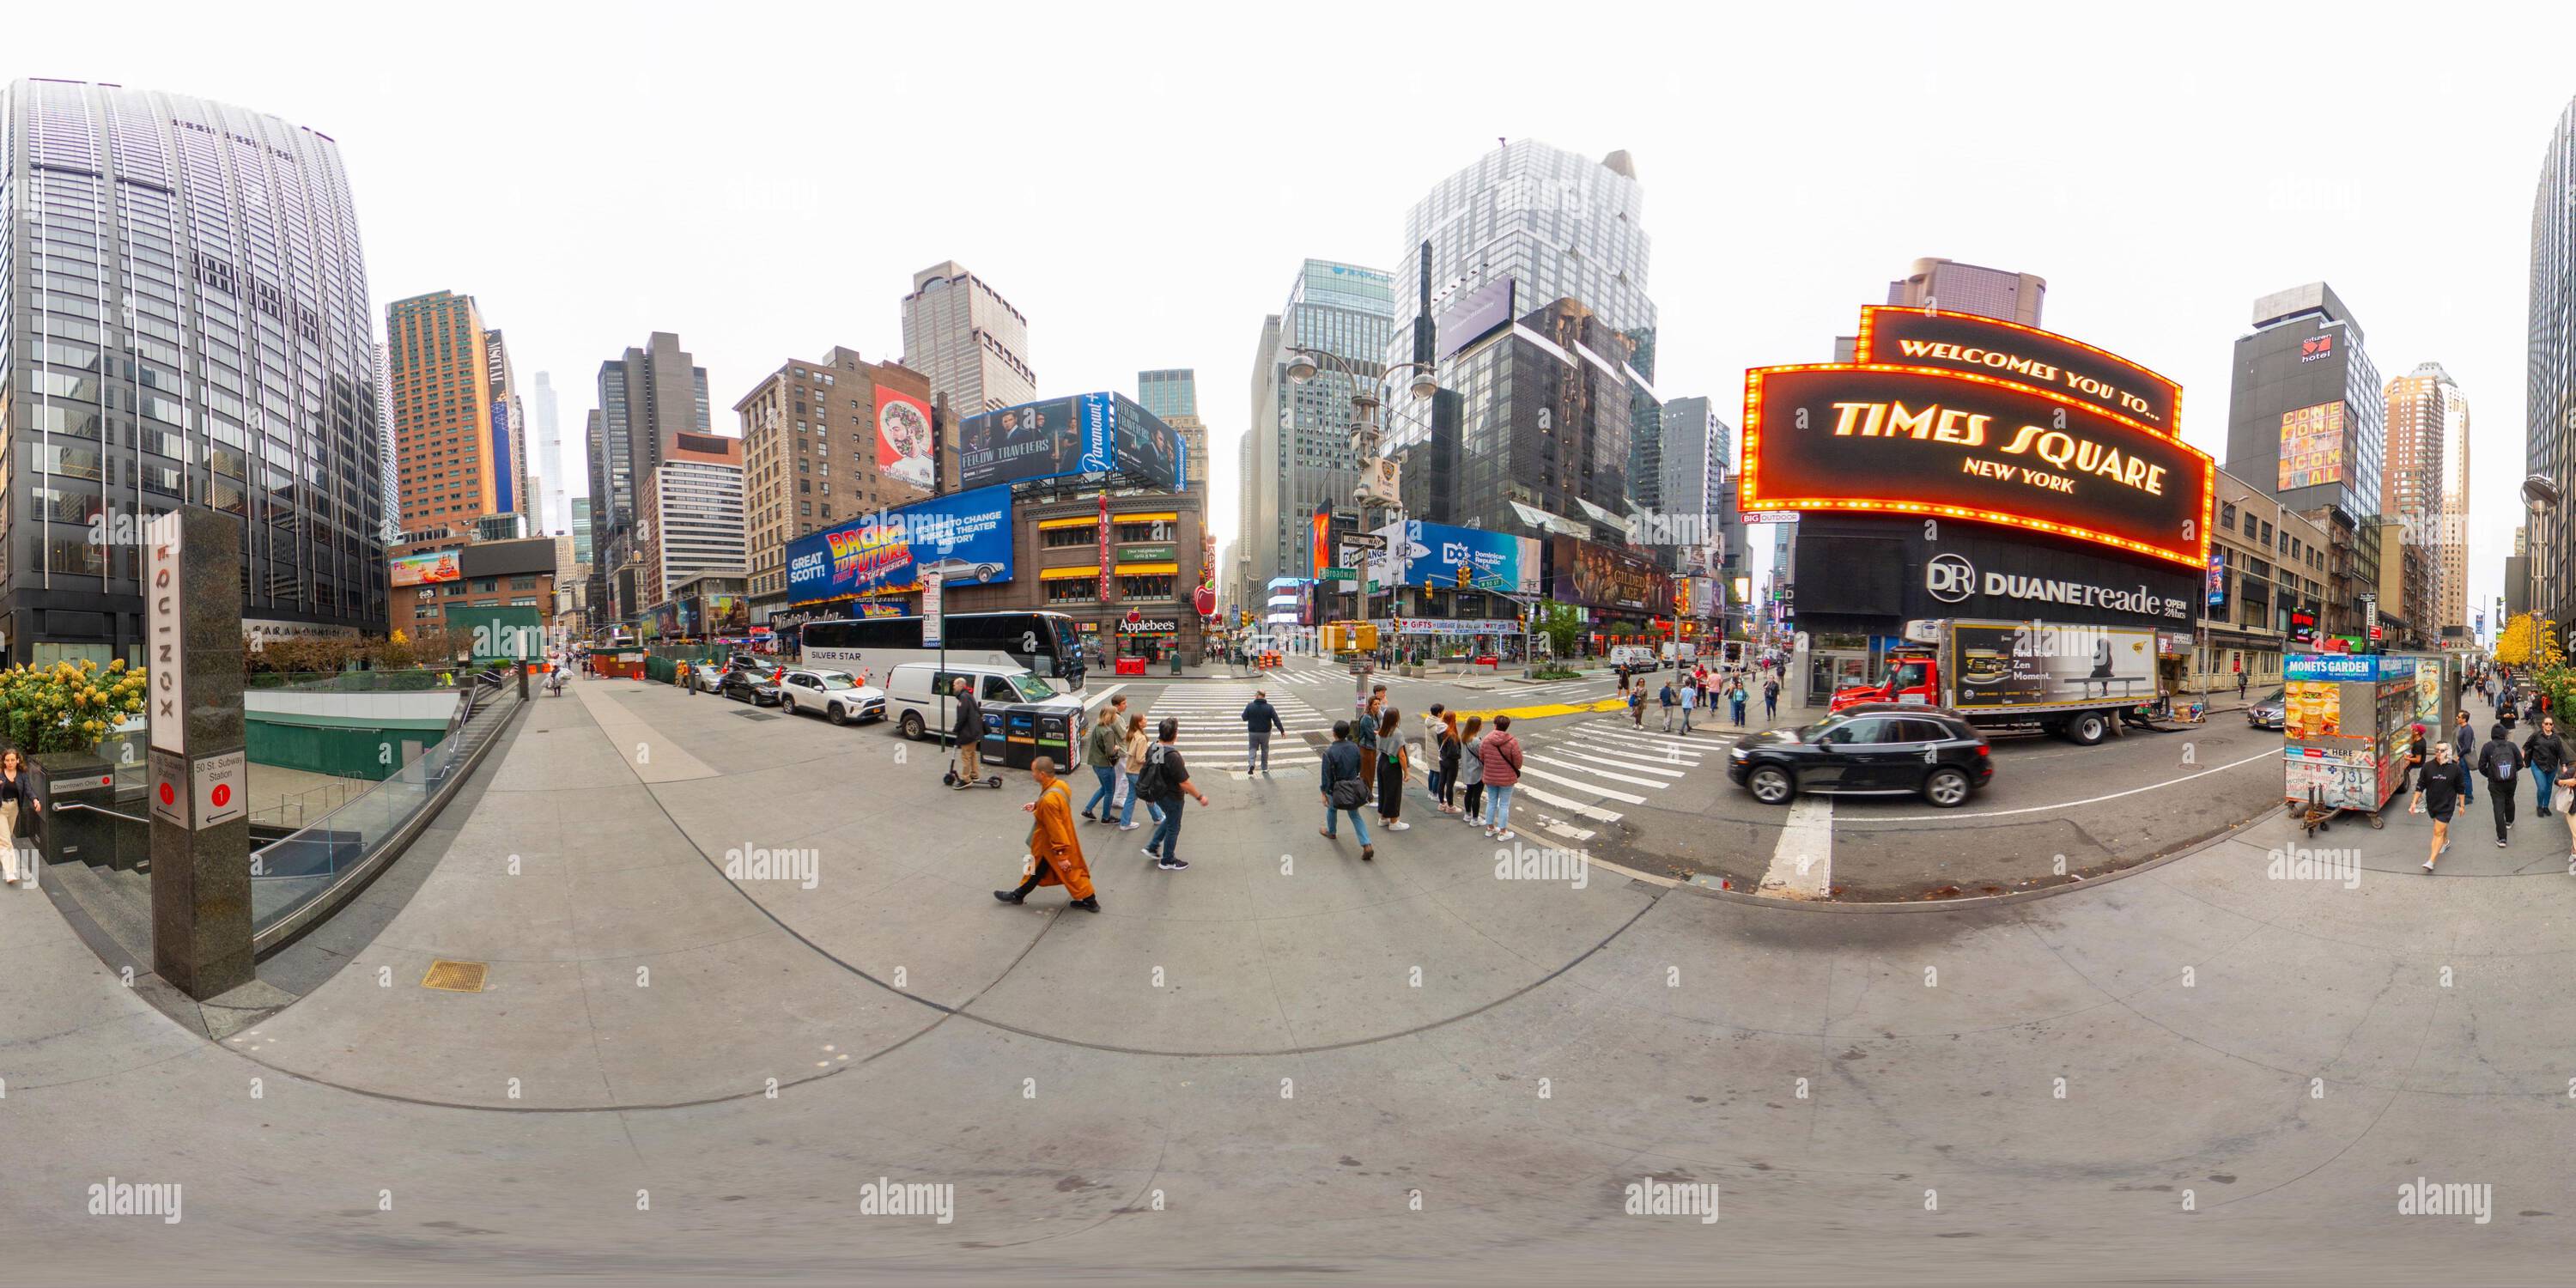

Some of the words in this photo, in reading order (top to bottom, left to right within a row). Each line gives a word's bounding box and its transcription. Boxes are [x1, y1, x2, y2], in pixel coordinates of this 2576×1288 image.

[2302, 350, 2330, 363] hotel
[1898, 339, 2059, 380] WELCOMES
[2064, 370, 2115, 399] YOU
[963, 450, 994, 468] FELLOW
[998, 439, 1049, 459] TRAVELERS
[1832, 400, 1993, 447] TIMES
[2000, 425, 2166, 495] SQUARE
[1963, 457, 2017, 481] NEW
[2021, 467, 2075, 494] YORK
[963, 511, 1002, 525] CHANGE
[957, 521, 996, 535] THEATER
[1369, 538, 1381, 547] WAY
[792, 552, 823, 570] GREAT
[848, 540, 909, 578] FUTURE
[1475, 550, 1506, 560] Dominican
[791, 565, 825, 583] SCOTT!
[1326, 568, 1357, 580] Broadway
[1614, 569, 1644, 588] GILDED
[1622, 586, 1638, 599] AGE
[2165, 598, 2186, 611] OPEN
[771, 611, 805, 631] Winter
[1119, 618, 1175, 634] Applebee's
[156, 544, 173, 719] EQUINOX
[2013, 648, 2032, 658] Find
[2013, 660, 2030, 669] Zen
[2328, 660, 2368, 672] GARDEN
[2014, 671, 2051, 680] Moment.
[196, 762, 205, 773] 50
[207, 761, 216, 771] St.
[218, 756, 243, 769] Subway
[209, 769, 232, 782] Station
[218, 789, 223, 802] 1
